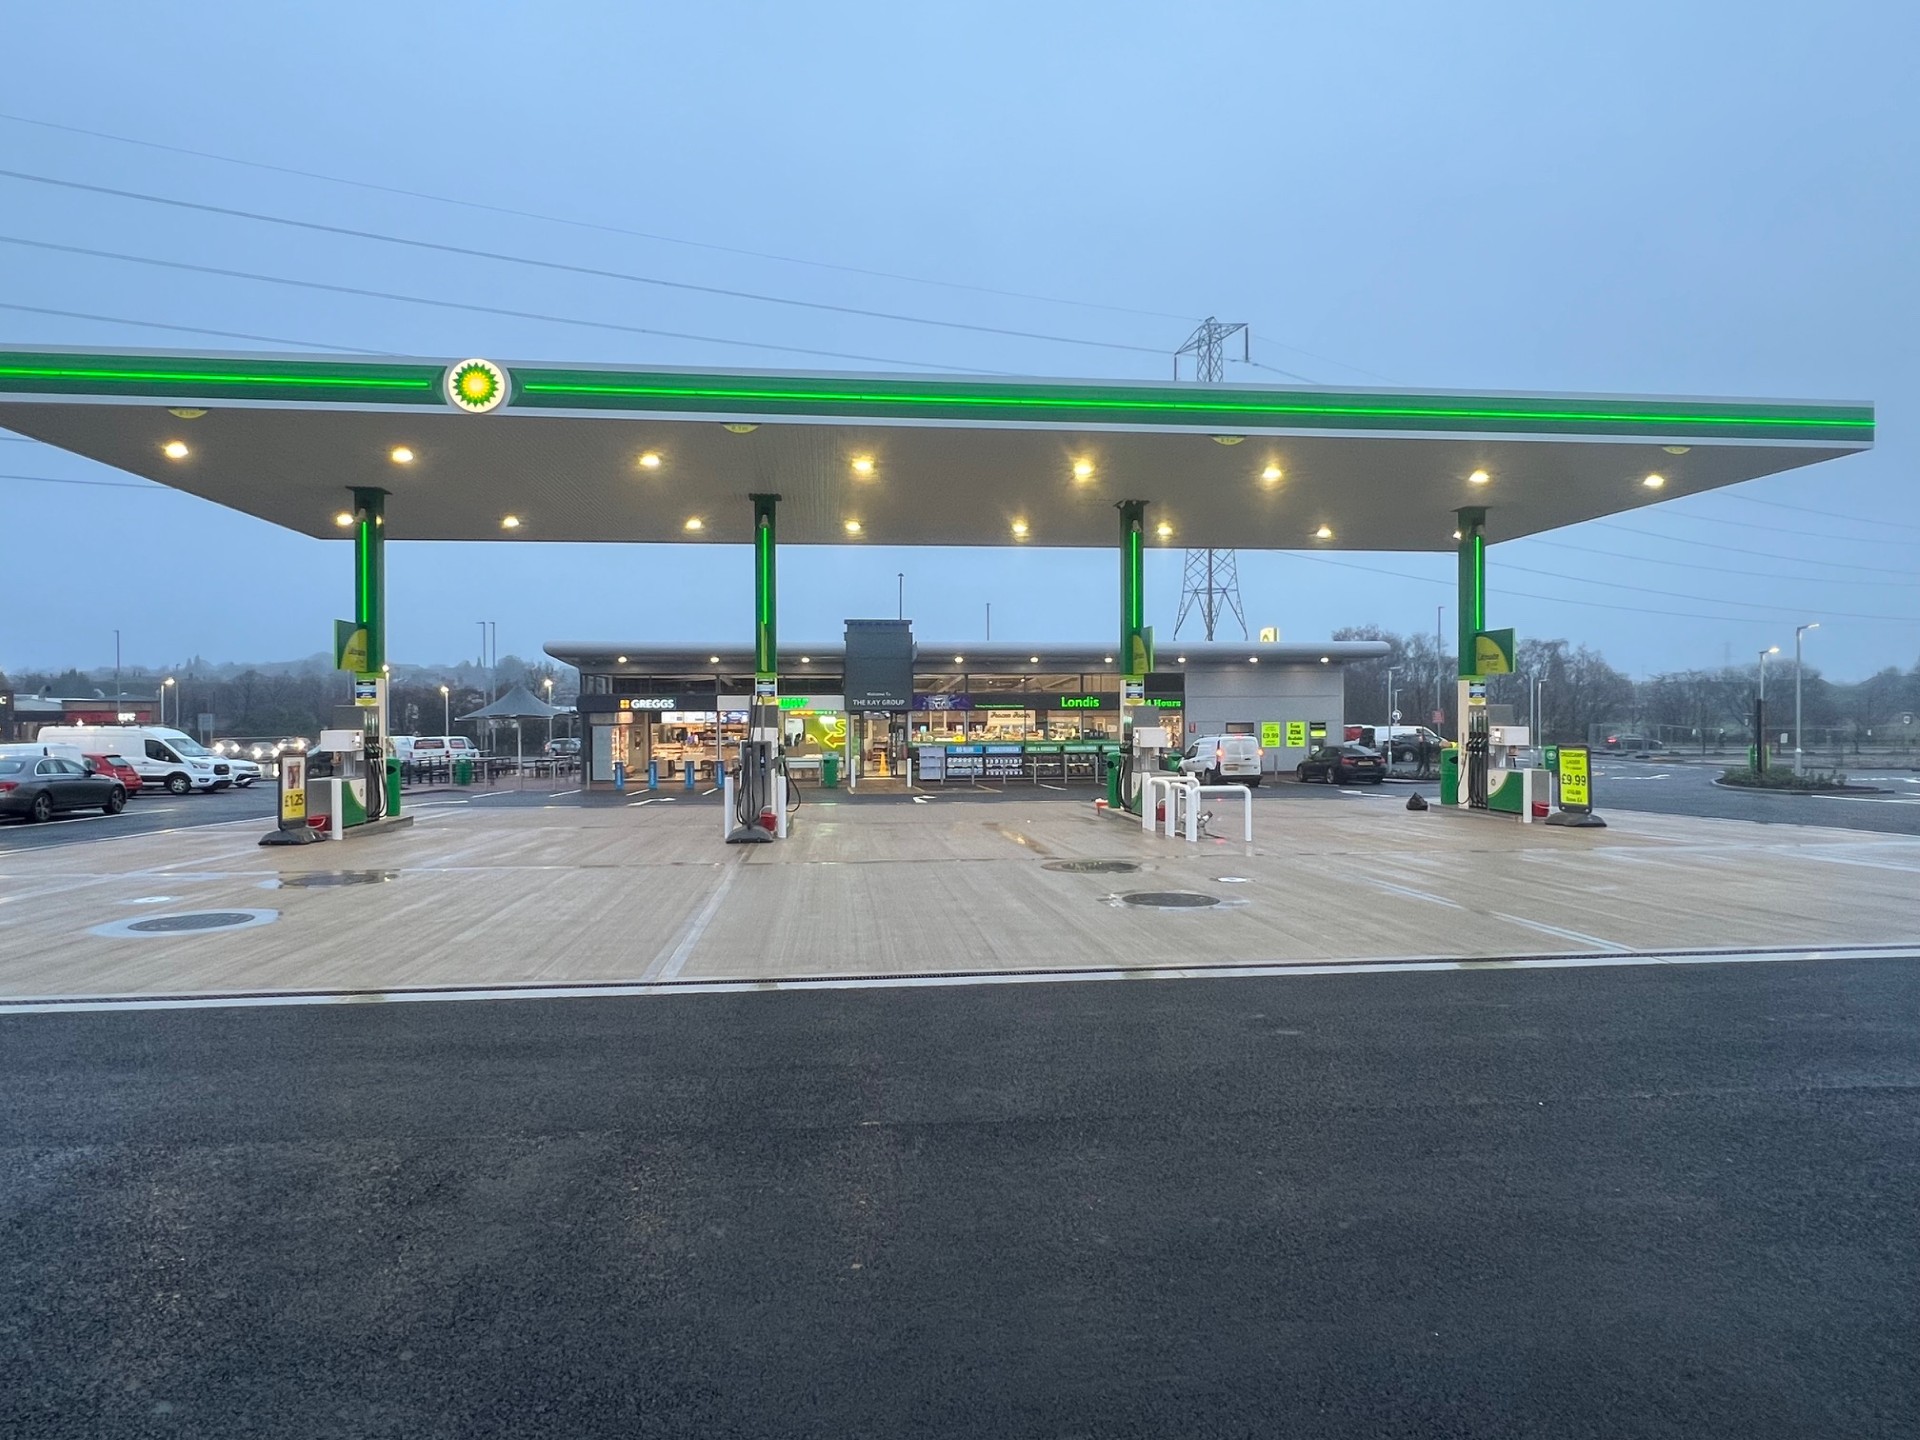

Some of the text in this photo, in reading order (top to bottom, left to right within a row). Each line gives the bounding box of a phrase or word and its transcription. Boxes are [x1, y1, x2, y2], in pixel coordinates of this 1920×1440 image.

[631, 699, 674, 709] GREGGS
[1061, 696, 1100, 708] Londis
[1153, 699, 1182, 707] Hours
[1561, 773, 1587, 787] £9.99
